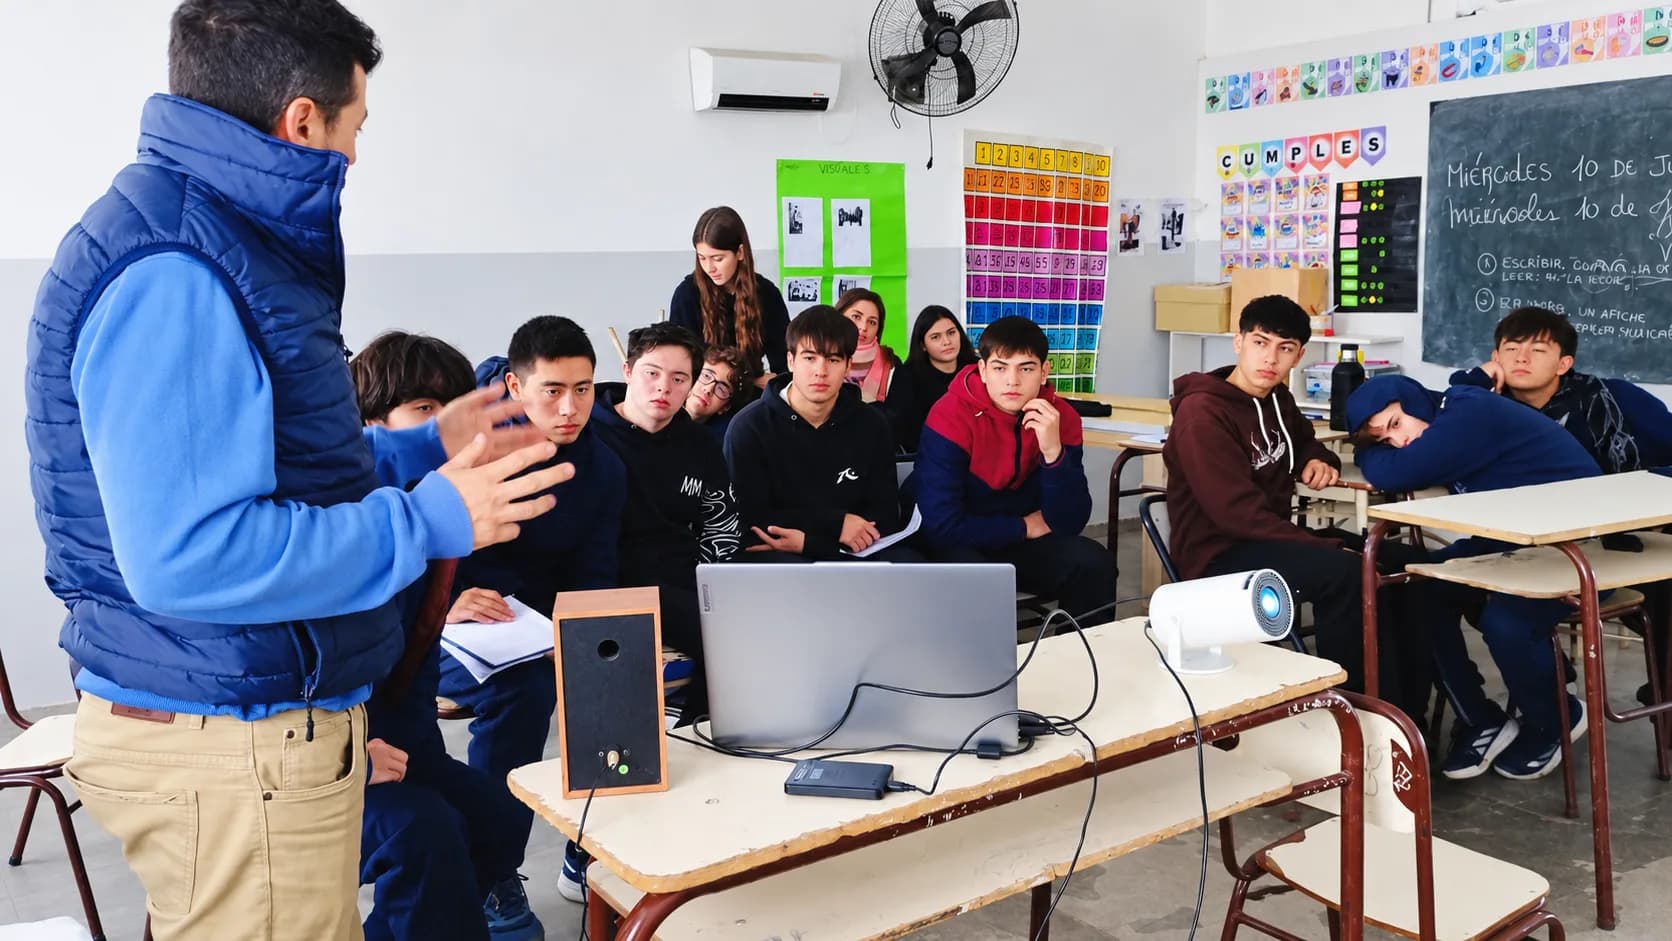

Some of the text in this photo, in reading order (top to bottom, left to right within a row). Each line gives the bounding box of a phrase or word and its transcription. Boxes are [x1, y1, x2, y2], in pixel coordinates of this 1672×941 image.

[997, 148, 1003, 161] 2
[1014, 150, 1020, 162] 3
[1028, 151, 1034, 163] 4
[1044, 153, 1050, 165] 5
[1096, 158, 1106, 171] 10
[1222, 137, 1379, 168] CUMPLES
[1572, 154, 1599, 182] 10
[1610, 160, 1637, 178] DE
[1574, 196, 1599, 221] 10
[1610, 193, 1638, 218] de
[1600, 309, 1647, 324] AFICHE
[680, 475, 703, 497] MM
